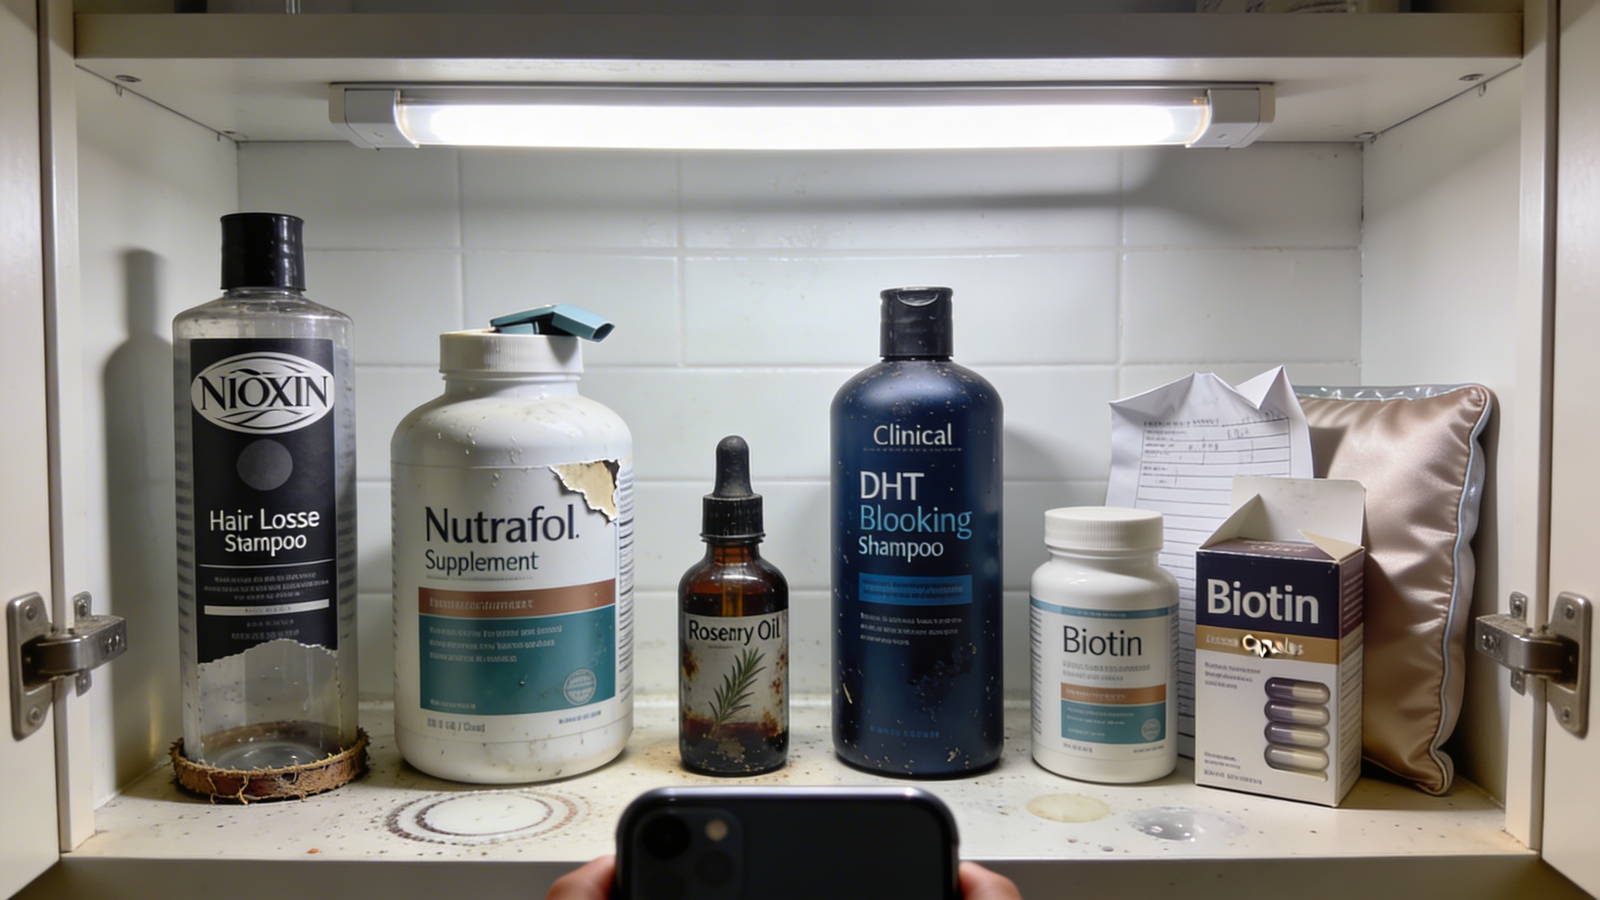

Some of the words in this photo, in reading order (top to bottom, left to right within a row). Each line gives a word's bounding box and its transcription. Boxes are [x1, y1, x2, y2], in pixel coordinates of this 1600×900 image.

[199, 375, 329, 410] NIOXIN
[873, 422, 953, 446] Clinical
[860, 470, 925, 501] DHT
[209, 509, 254, 532] Hair
[260, 508, 321, 530] Losse
[859, 504, 973, 540] Blooking
[425, 549, 540, 576] Supplement
[858, 534, 944, 563] Shampoo
[1206, 578, 1319, 625] Biotin
[757, 616, 781, 641] Oil
[1062, 624, 1143, 657] Biotin
